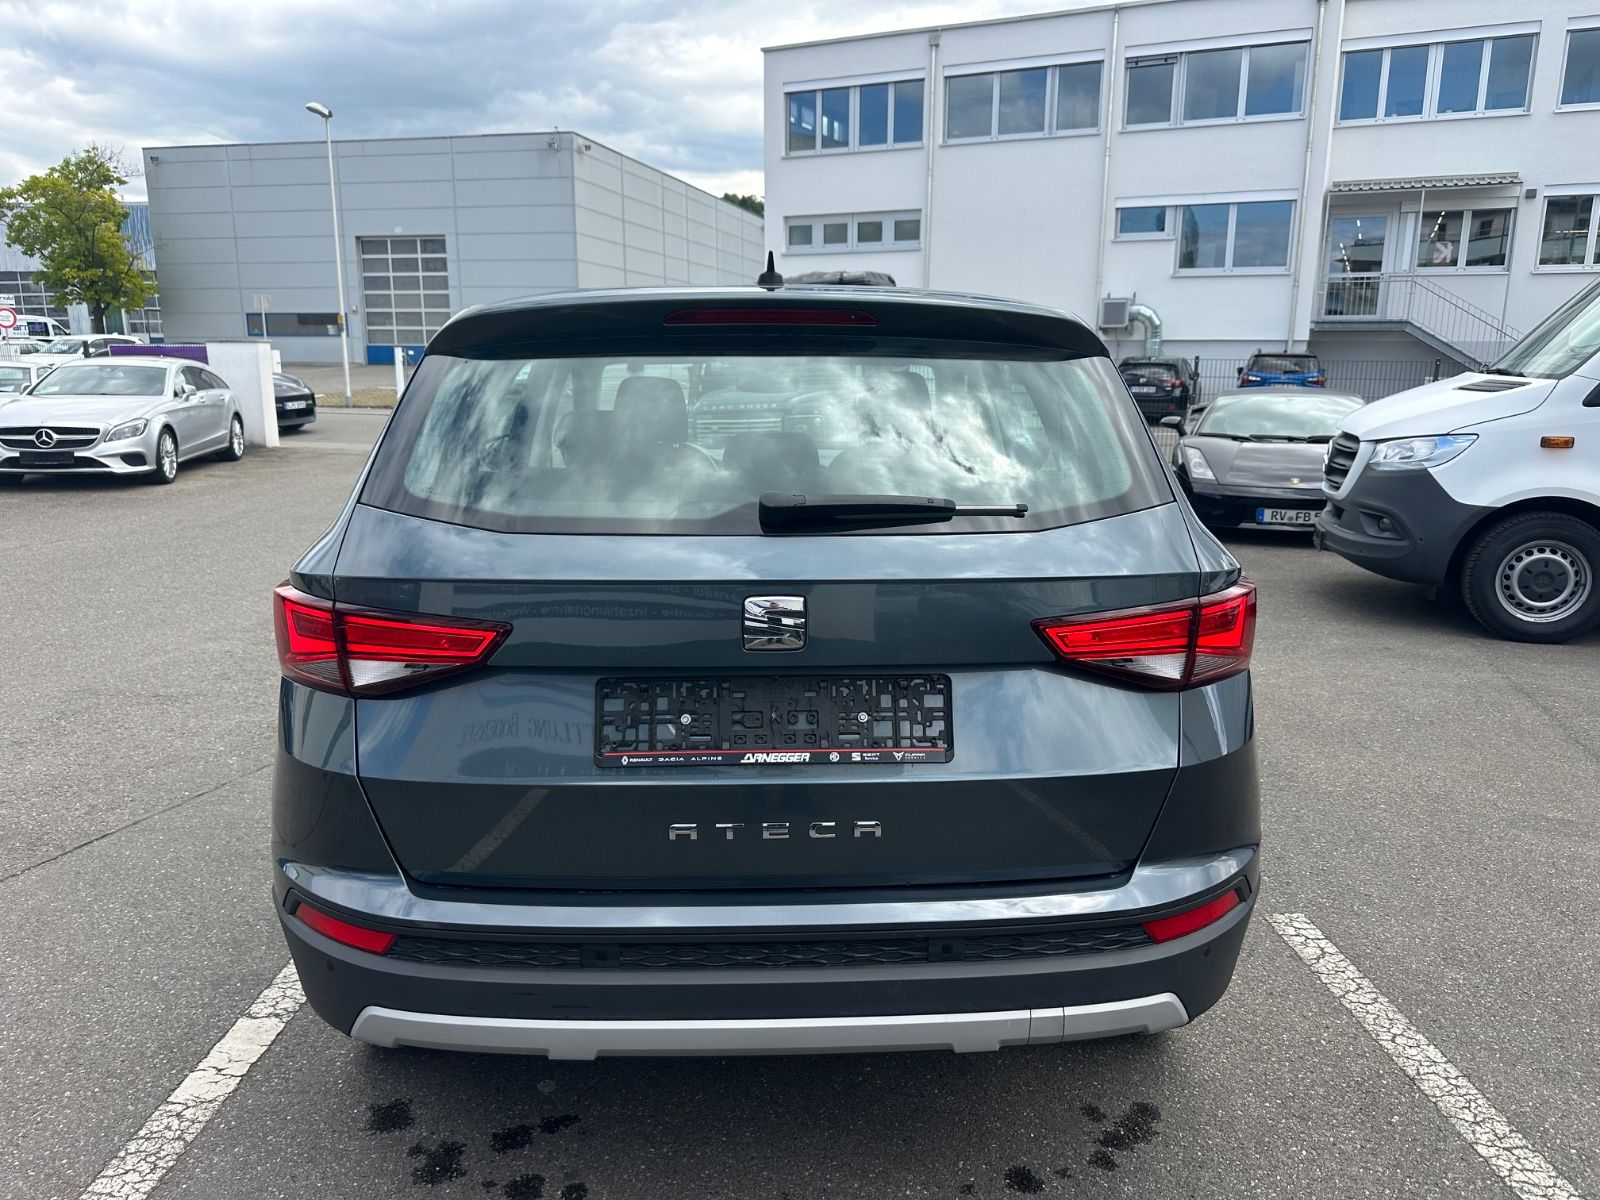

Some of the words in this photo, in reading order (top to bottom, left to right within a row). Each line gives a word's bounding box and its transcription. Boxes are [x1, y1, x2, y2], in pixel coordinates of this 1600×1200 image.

[1271, 510, 1287, 521] RV
[1295, 511, 1311, 522] FB
[740, 752, 811, 763] ARNEGGER
[669, 820, 882, 841] ATECA
